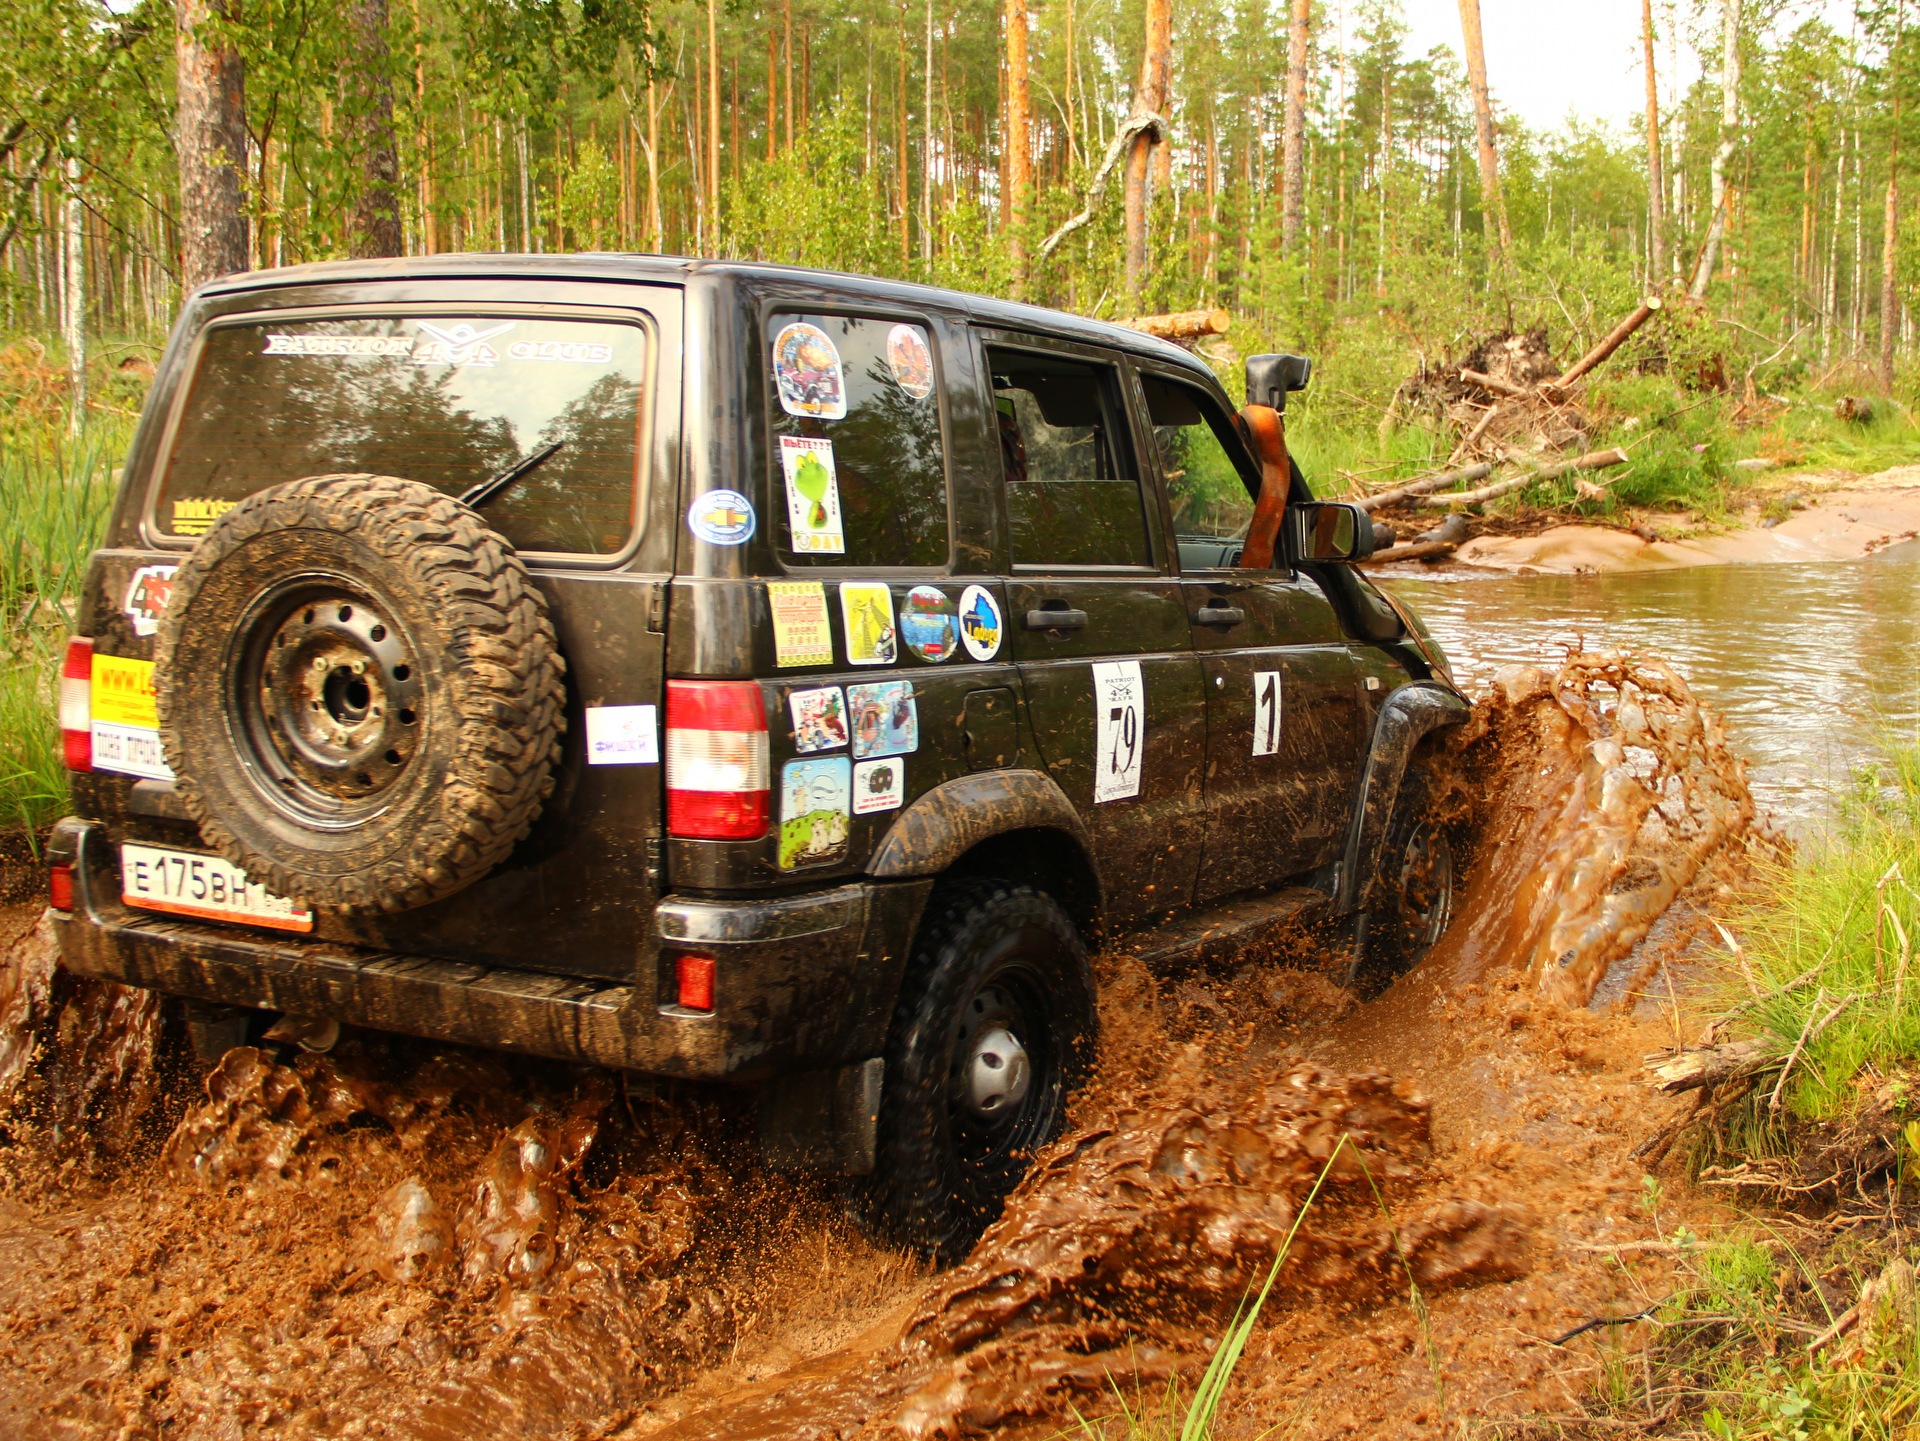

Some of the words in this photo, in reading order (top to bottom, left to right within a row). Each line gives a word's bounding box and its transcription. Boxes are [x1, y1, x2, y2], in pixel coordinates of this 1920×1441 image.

[262, 335, 414, 356] PATRIOT
[506, 340, 613, 363] CLUB
[1105, 676, 1136, 684] PATRIOT
[1261, 675, 1276, 753] 1
[1109, 705, 1137, 775] 79
